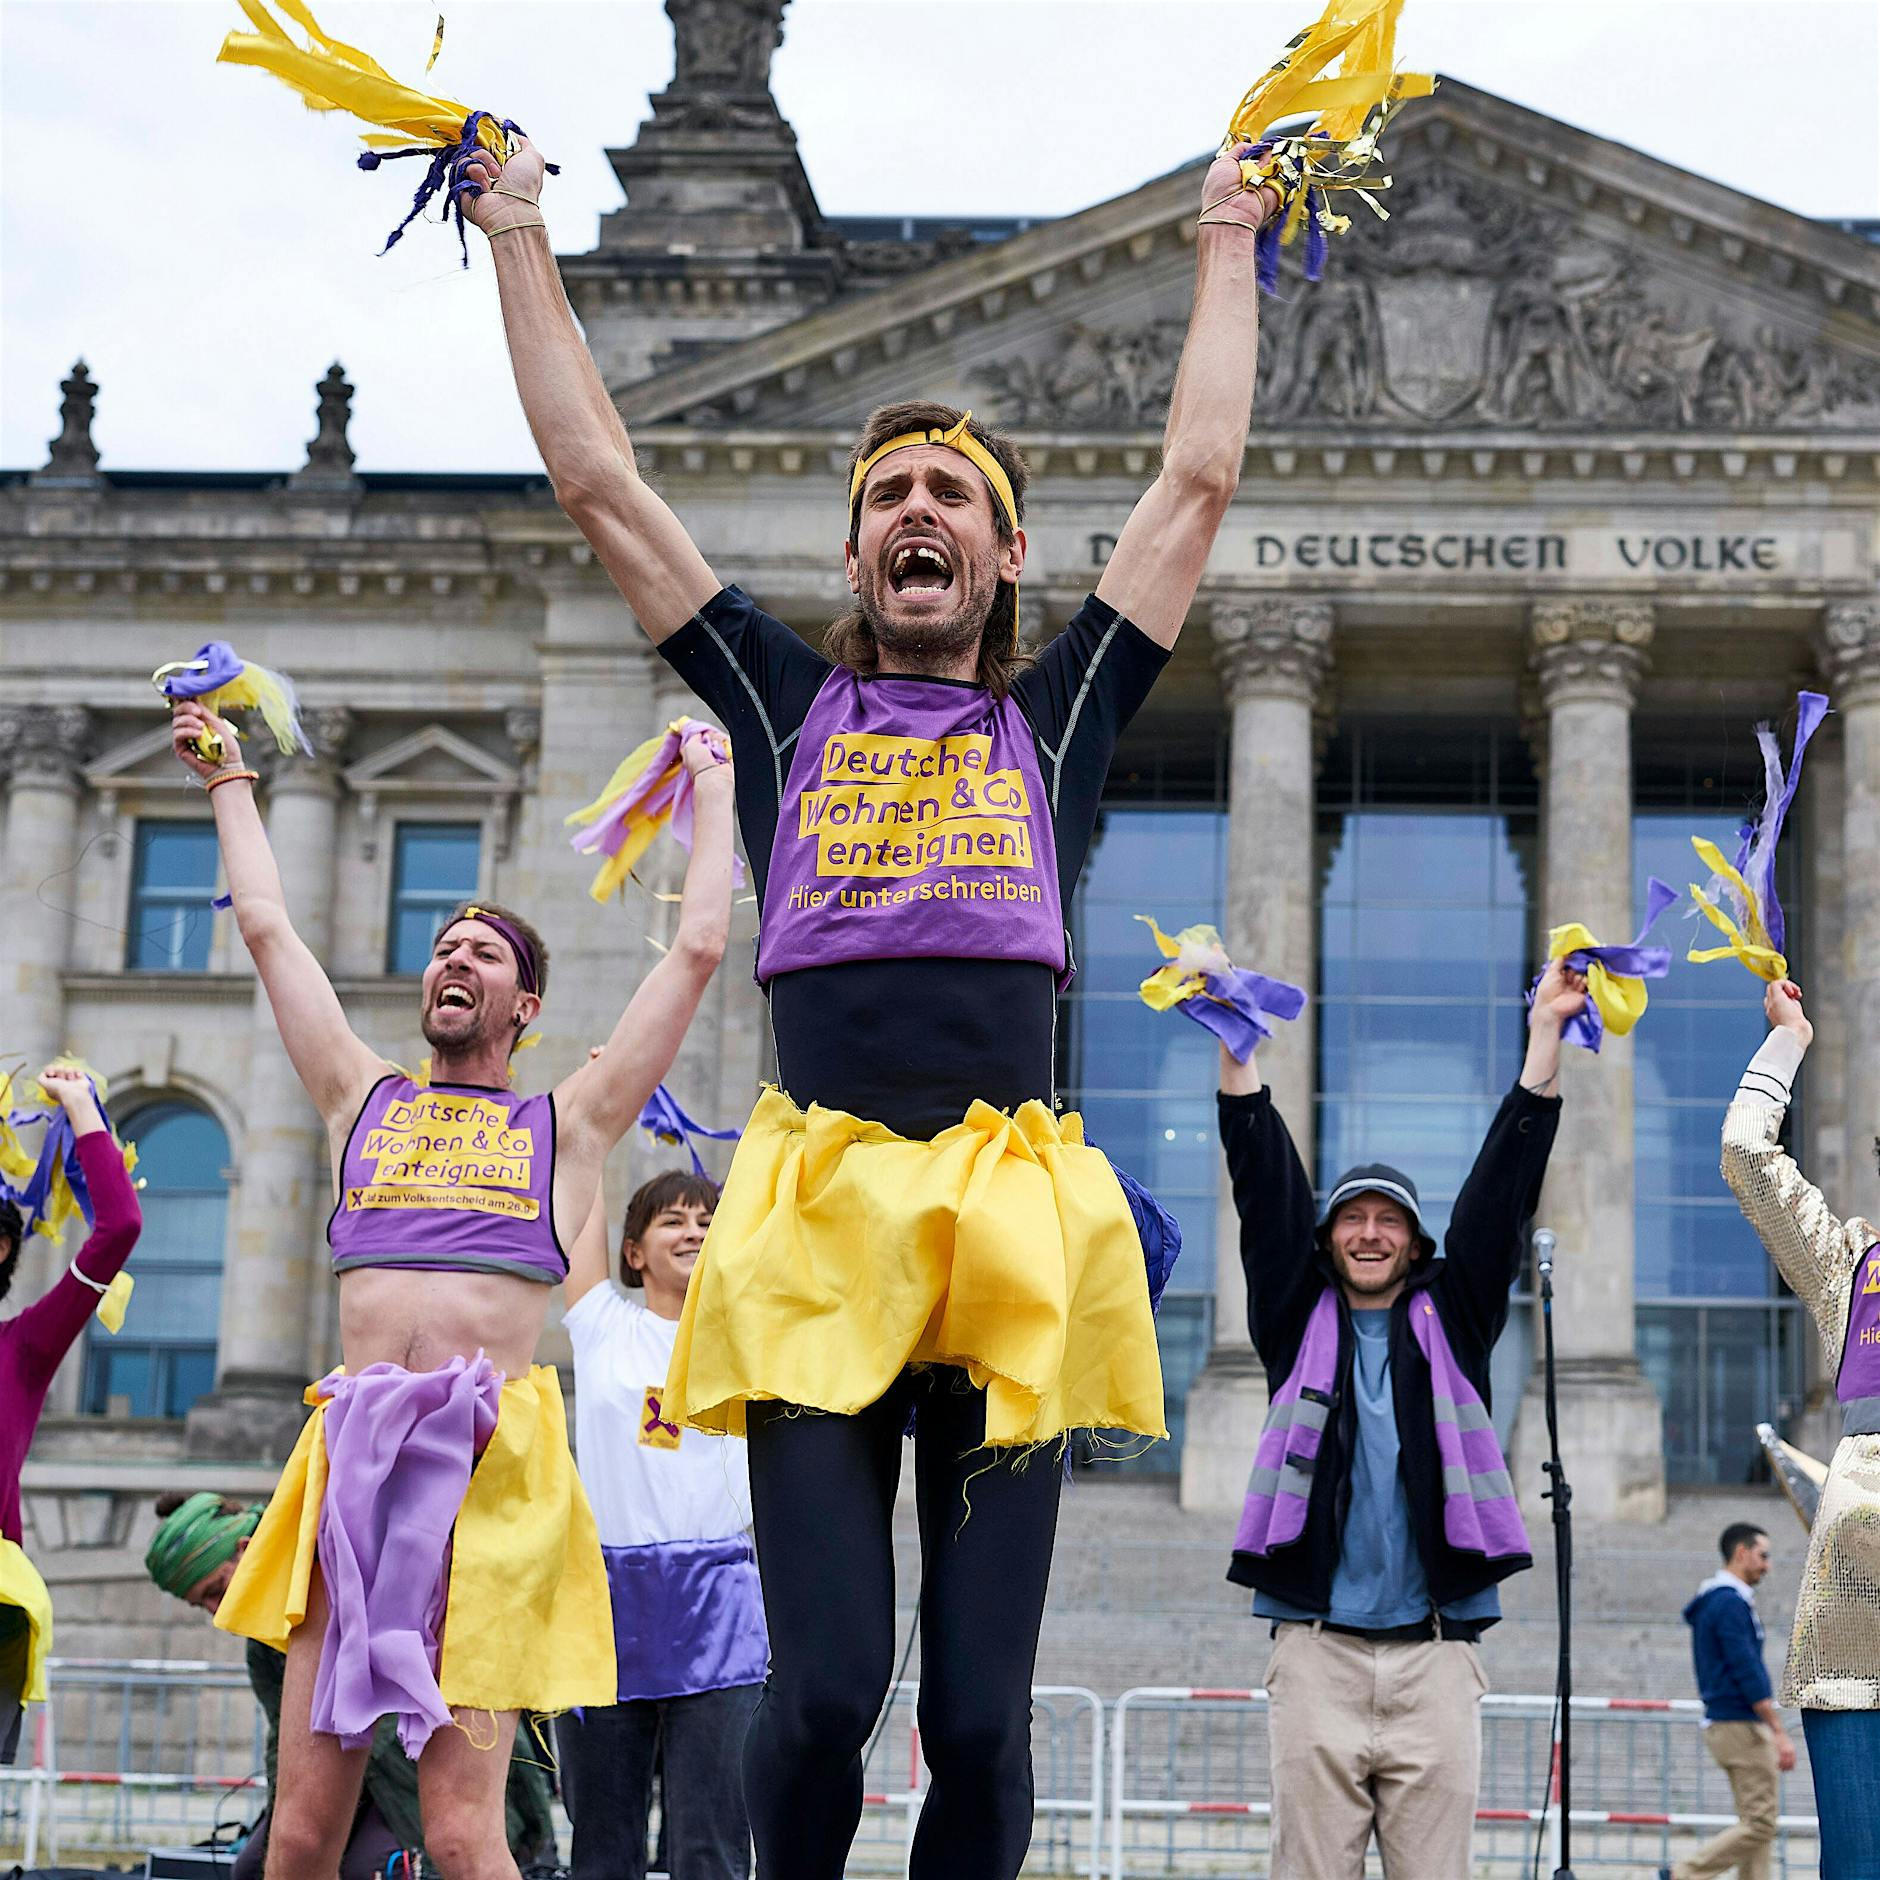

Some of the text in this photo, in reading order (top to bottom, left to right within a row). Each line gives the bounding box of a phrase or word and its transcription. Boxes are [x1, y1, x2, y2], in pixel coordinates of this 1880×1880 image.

[1255, 534, 1778, 570] DEUTSCHEN VOLKE
[806, 777, 1022, 828] Wohnen & Co
[827, 826, 1025, 867] enteignen!
[787, 874, 1041, 910] Hier unterschreiben
[471, 1130, 489, 1149] &
[497, 1131, 528, 1152] Co
[382, 1159, 524, 1185] enteignen!
[378, 1194, 401, 1203] zum
[403, 1193, 486, 1206] Volksentscheid
[487, 1200, 505, 1209] am
